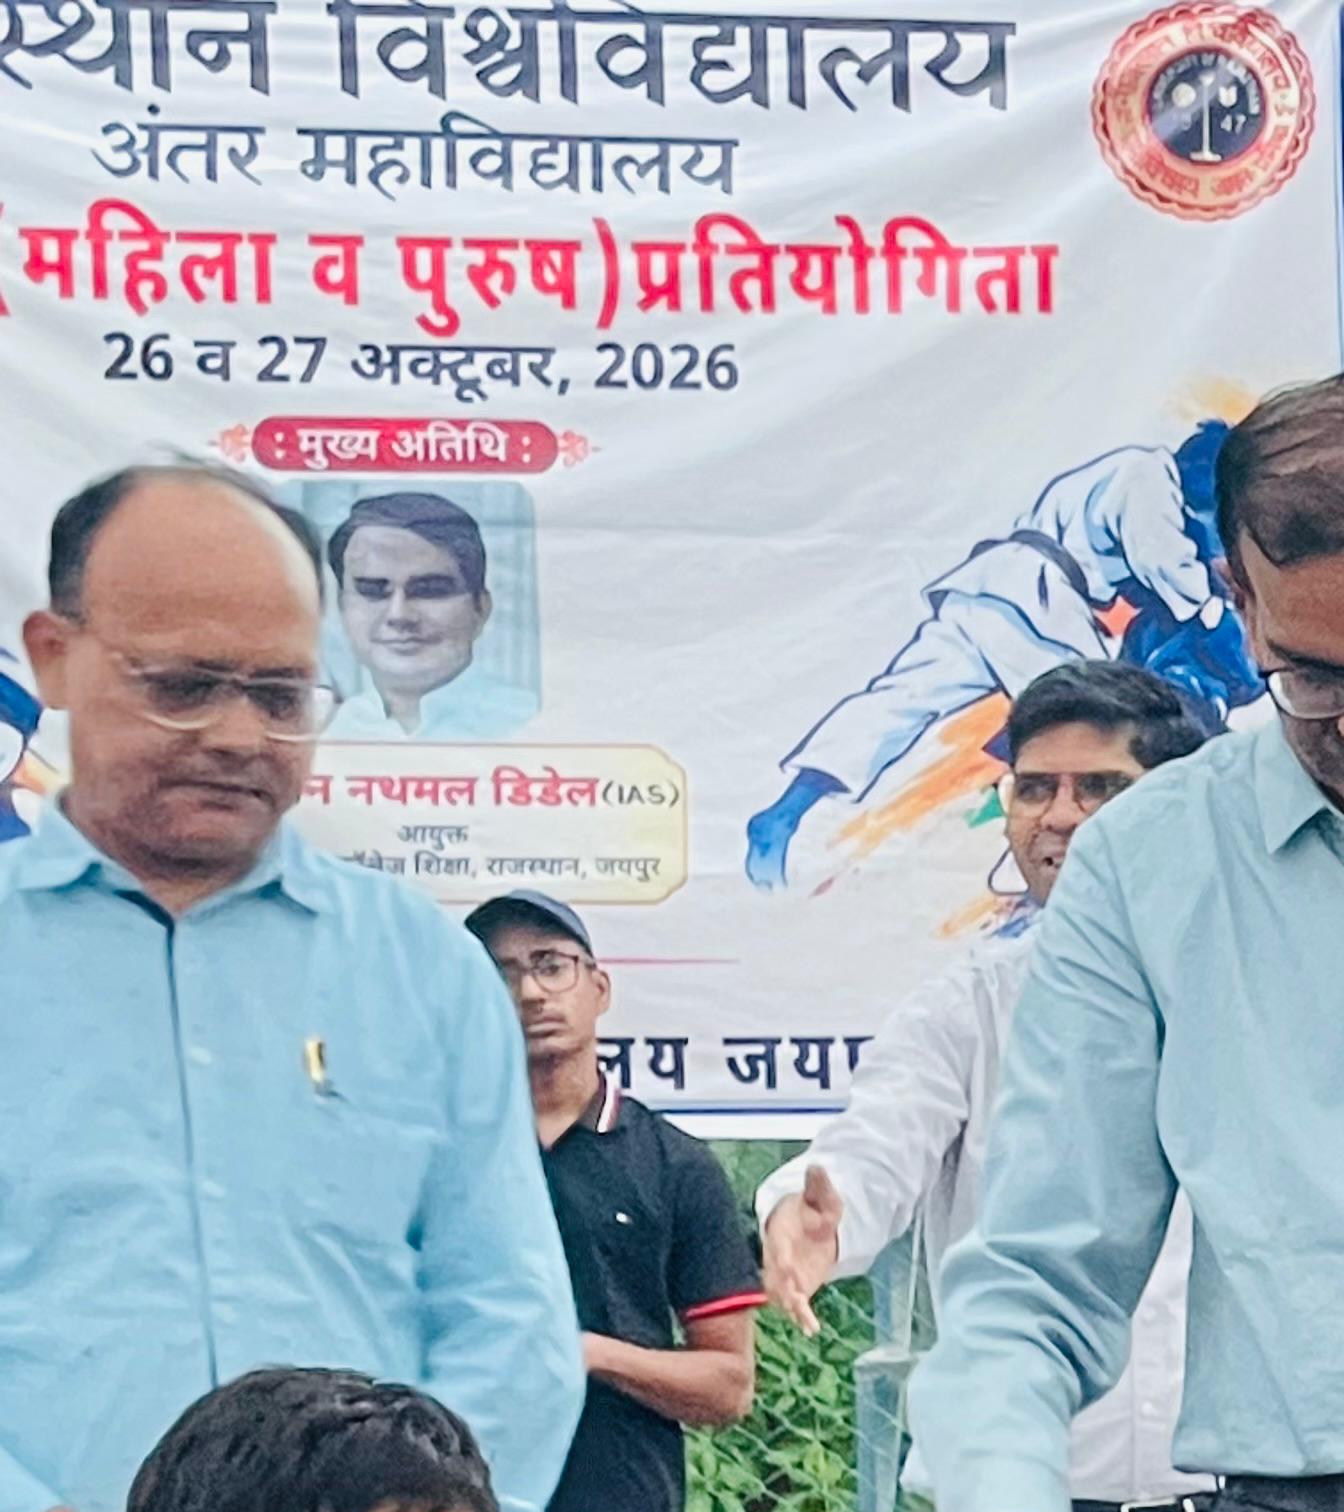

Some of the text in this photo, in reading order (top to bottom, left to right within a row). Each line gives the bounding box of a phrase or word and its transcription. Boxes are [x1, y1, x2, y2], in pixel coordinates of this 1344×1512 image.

[91, 103, 739, 201] अंतर महाविद्यालय
[308, 234, 365, 306] व
[103, 331, 738, 402] 26 व 27 अक्टूबर, 2026
[297, 429, 380, 469] मुख्य
[392, 421, 508, 461] अतिथि
